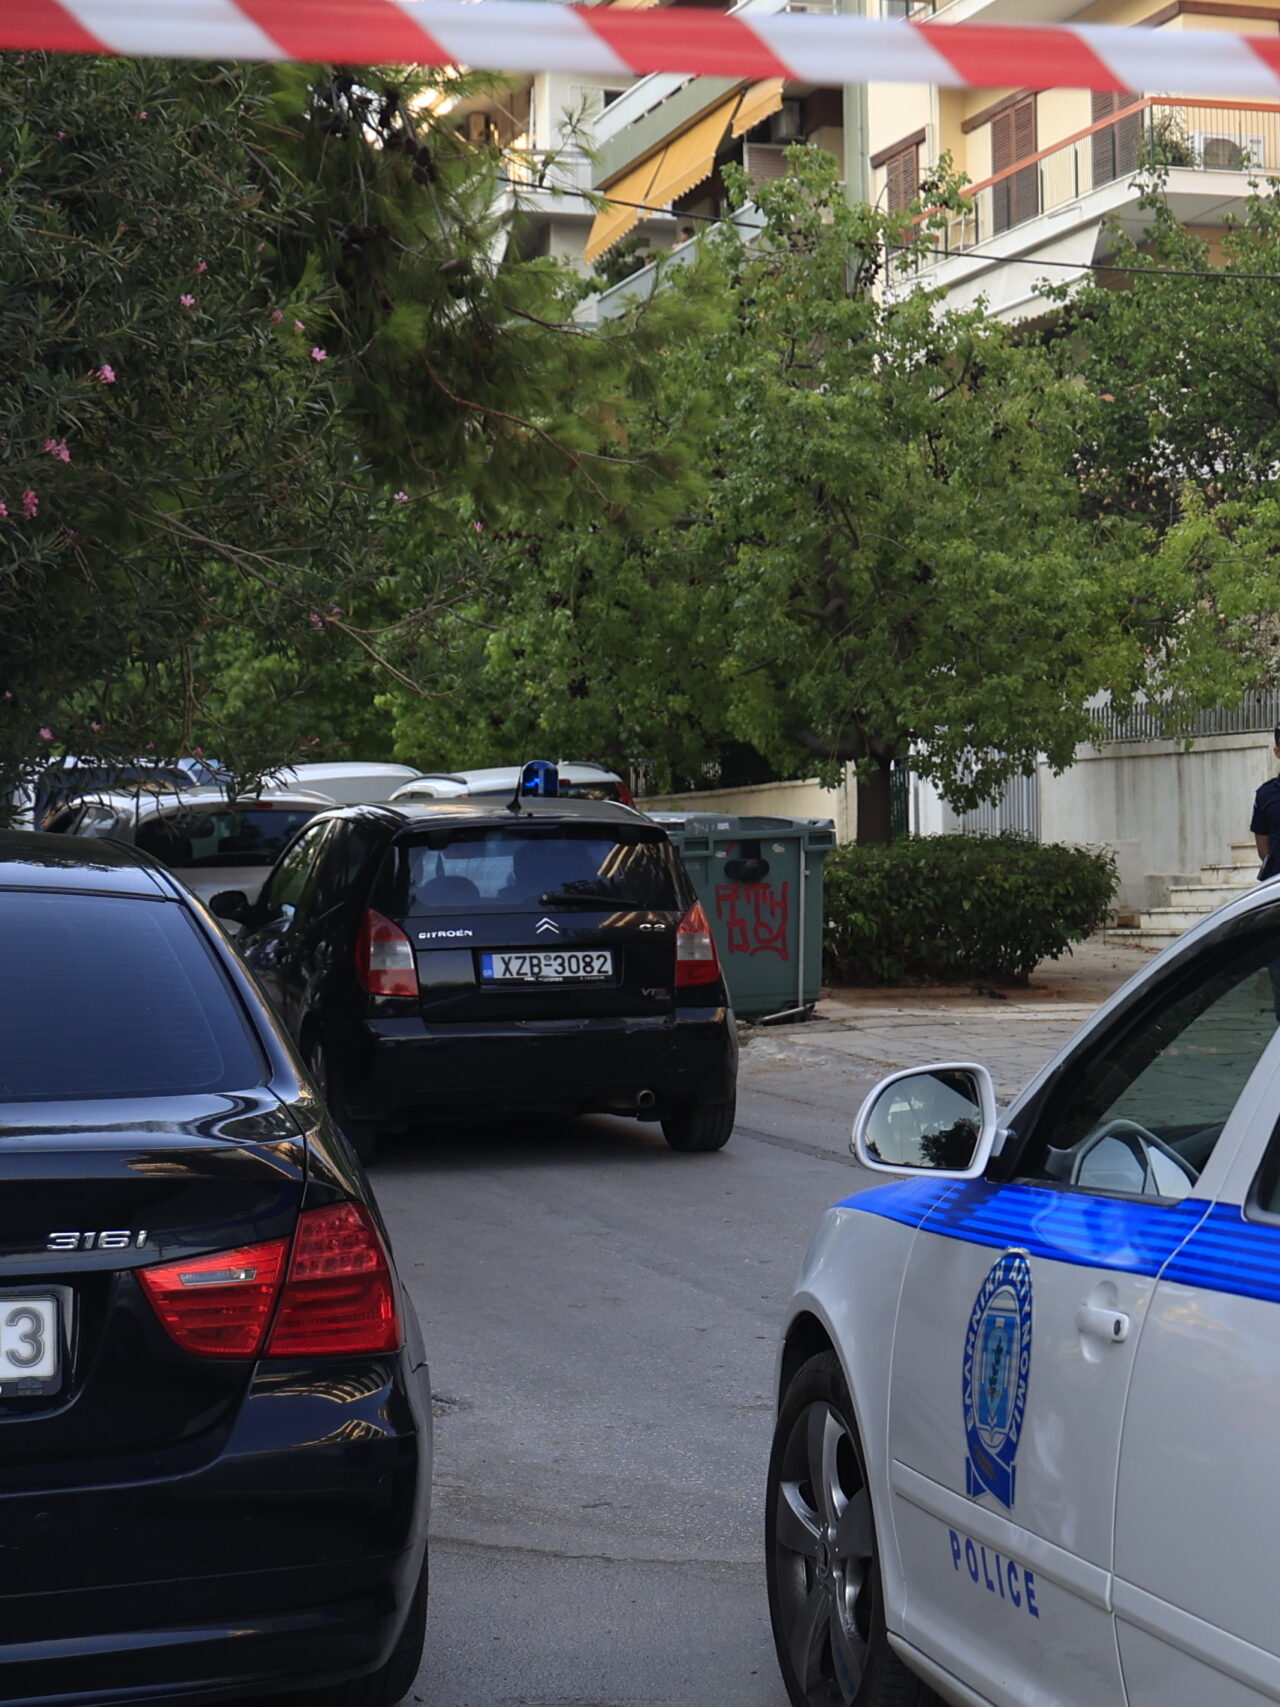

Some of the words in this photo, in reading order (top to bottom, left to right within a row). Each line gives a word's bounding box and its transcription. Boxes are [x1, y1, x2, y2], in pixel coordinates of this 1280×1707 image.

[638, 923, 667, 933] C2
[501, 953, 610, 977] XZB-3082
[47, 1229, 148, 1250] 316i
[0, 1306, 46, 1369] 3
[949, 1528, 1040, 1619] POLICE
